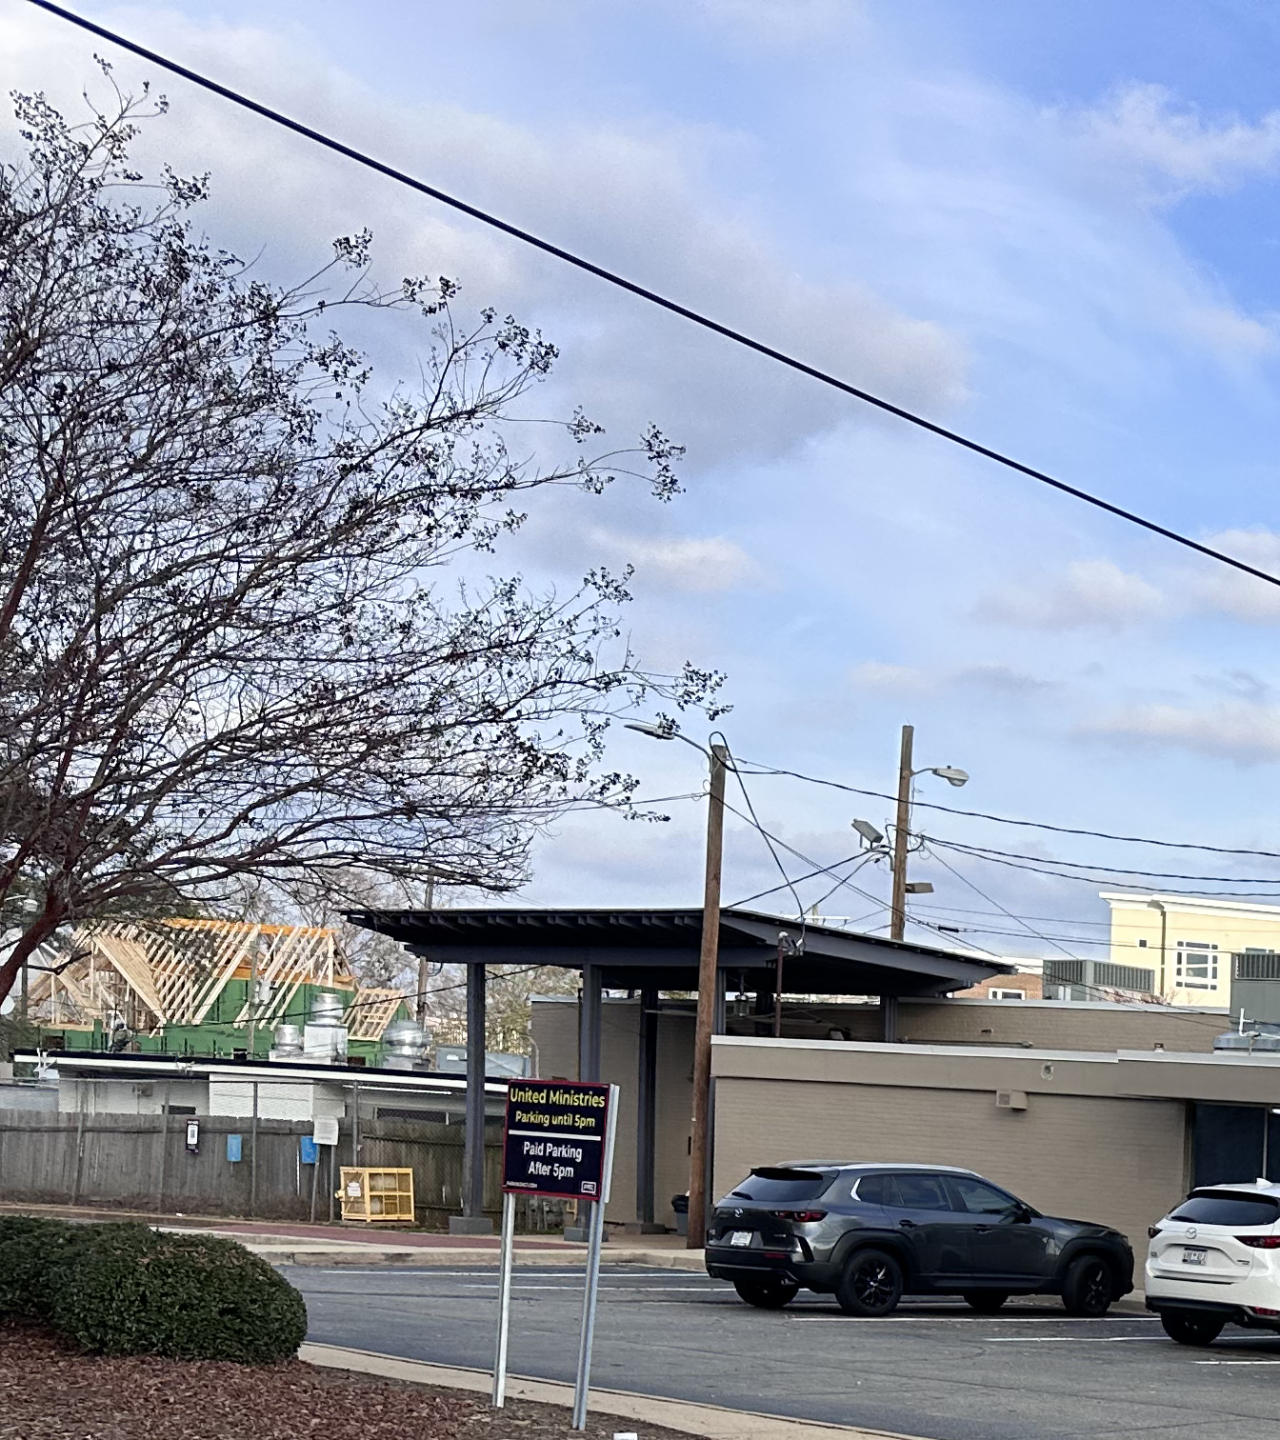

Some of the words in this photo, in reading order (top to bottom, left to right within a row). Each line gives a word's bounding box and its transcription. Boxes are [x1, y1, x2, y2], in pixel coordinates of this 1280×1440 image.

[510, 1088, 547, 1104] United
[549, 1090, 605, 1107] Ministries
[515, 1110, 549, 1127] Parking
[551, 1113, 573, 1125] until
[574, 1116, 595, 1129] 5pm
[523, 1141, 543, 1156] Paid
[546, 1143, 582, 1162] Parking
[528, 1161, 551, 1176] After
[553, 1164, 574, 1180] 5pm
